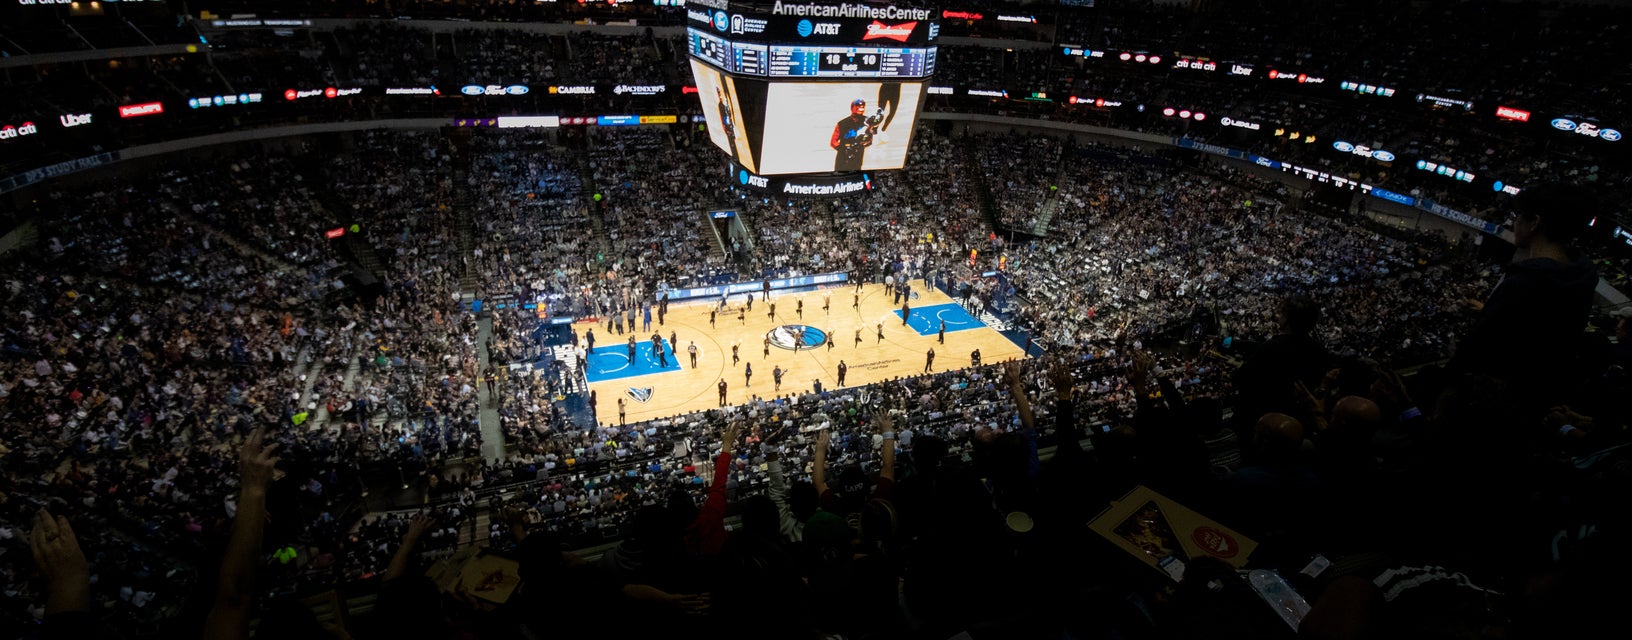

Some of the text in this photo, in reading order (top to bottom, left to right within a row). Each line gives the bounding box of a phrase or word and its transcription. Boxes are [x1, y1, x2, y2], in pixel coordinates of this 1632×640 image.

[814, 23, 841, 35] AT&T
[826, 54, 841, 65] 18
[862, 54, 877, 65] 10
[1232, 65, 1252, 76] Uber
[558, 86, 595, 94] CAMBRIA
[60, 113, 92, 127] Uber
[1575, 122, 1600, 137] Ford
[1352, 145, 1374, 158] Ford
[45, 160, 76, 176] STUDY
[78, 154, 102, 169] HALL
[1255, 156, 1273, 167] Ford
[748, 176, 769, 188] AT&T
[783, 181, 864, 195] American Airlines
[1447, 209, 1488, 229] SCHOLARS
